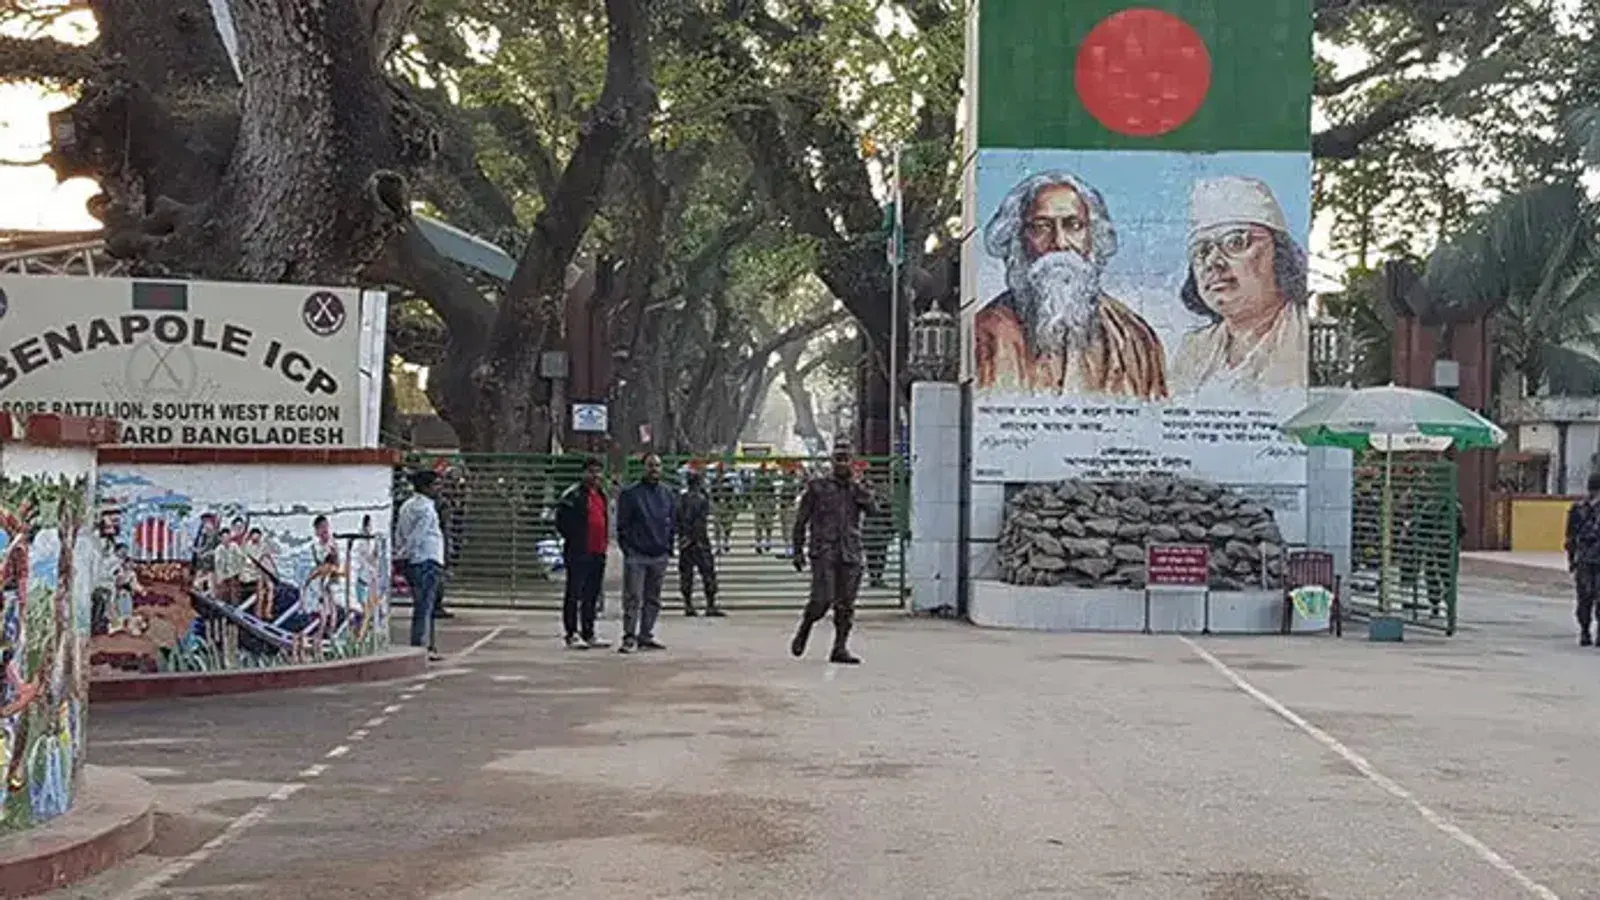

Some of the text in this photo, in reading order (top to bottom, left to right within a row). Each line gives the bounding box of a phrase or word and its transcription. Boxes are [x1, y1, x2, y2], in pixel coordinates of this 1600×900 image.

[0, 315, 338, 395] BENAPOLE ICP
[152, 404, 214, 420] SOUTH
[219, 405, 269, 421] WEST
[275, 406, 340, 421] REGION
[121, 427, 343, 444] ARD BANGLADESH
